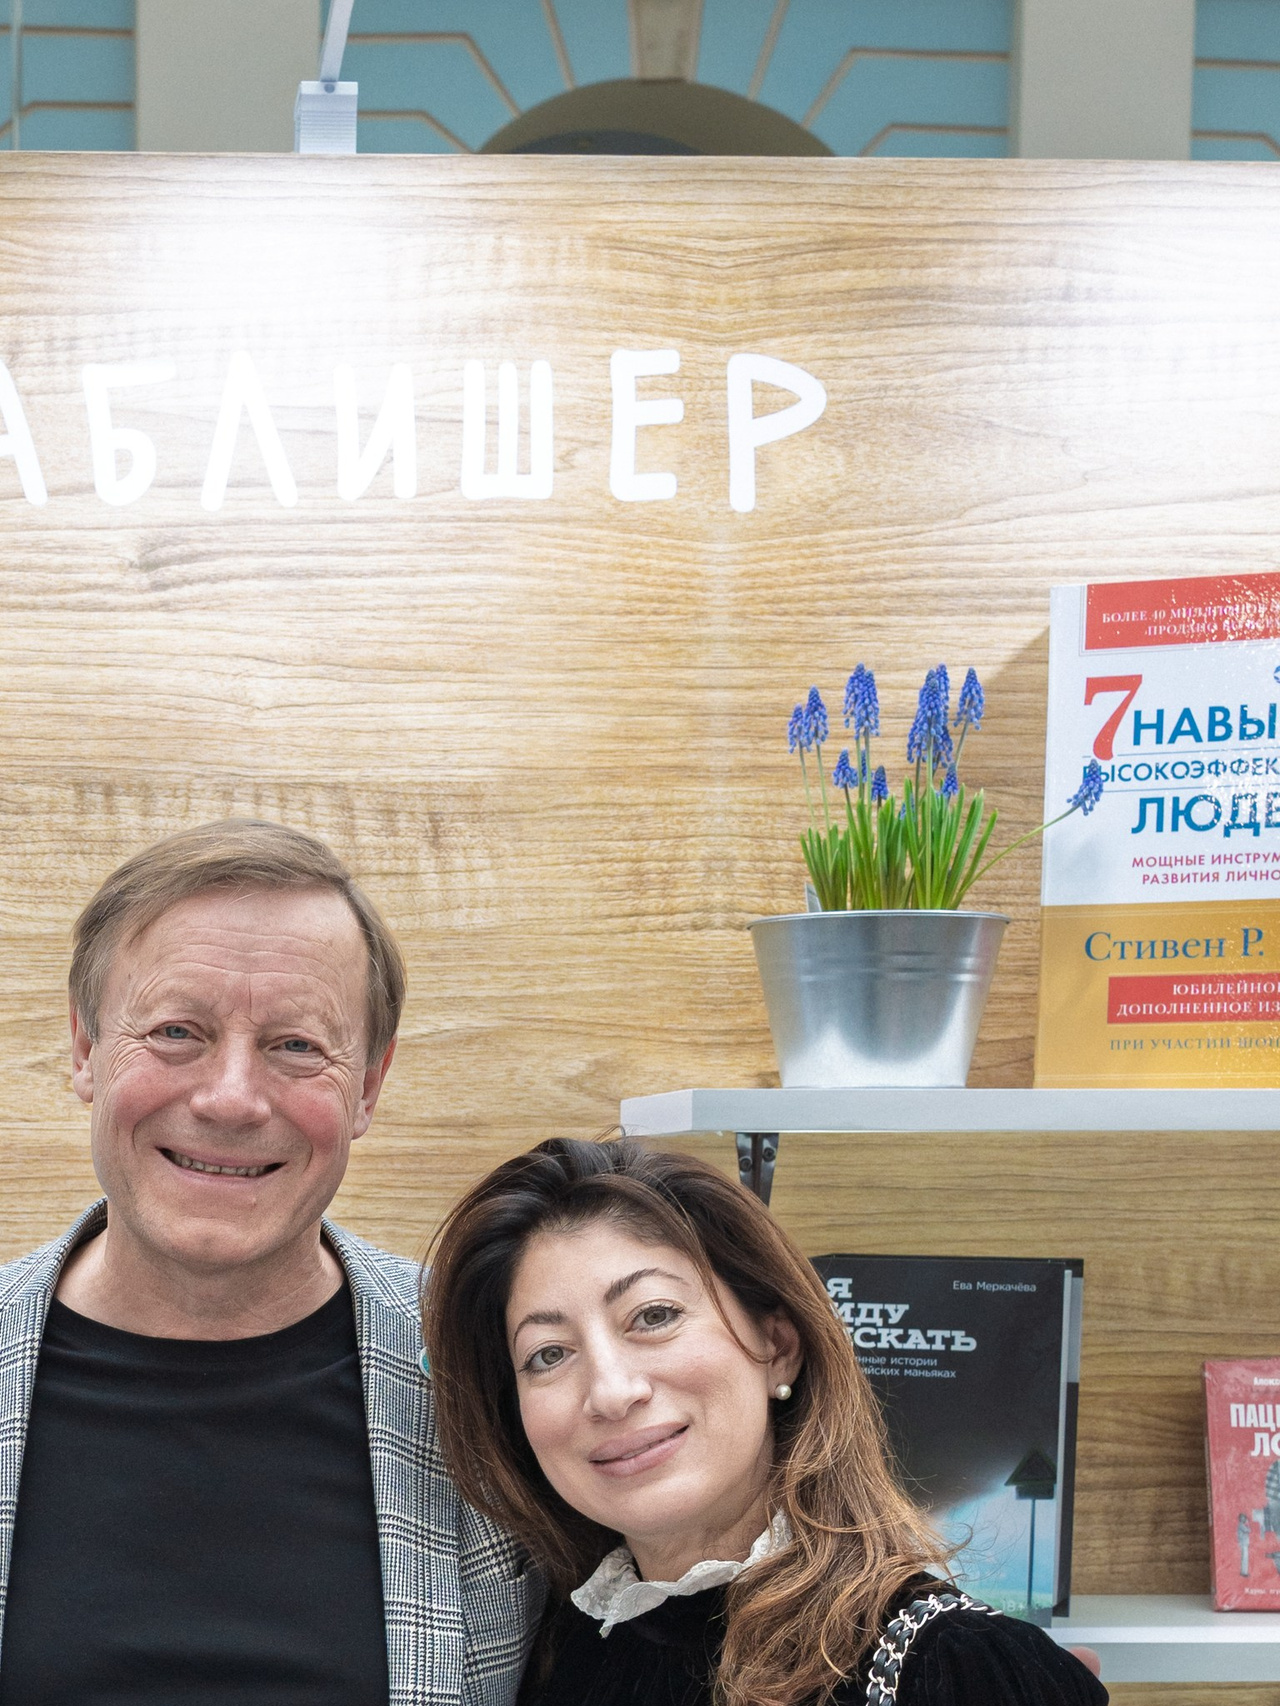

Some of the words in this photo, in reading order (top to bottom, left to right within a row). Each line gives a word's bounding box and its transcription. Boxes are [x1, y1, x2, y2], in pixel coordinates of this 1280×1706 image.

[1084, 674, 1143, 761] 7
[1132, 854, 1206, 868] МОЩНЫЕ
[1142, 872, 1220, 885] РАЗВИТИЯ
[1084, 931, 1226, 961] Стивен
[1240, 927, 1265, 957] Р.
[1116, 1001, 1253, 1016] ДОПОЛНЕННОЕ
[1110, 1039, 1144, 1051] ПРИ
[826, 1277, 853, 1299] Я
[953, 1280, 973, 1291] Ева
[976, 1280, 1037, 1293] Меркачёва
[890, 1356, 938, 1367] истории
[861, 1365, 900, 1376] ийских
[904, 1367, 957, 1379] маньяках
